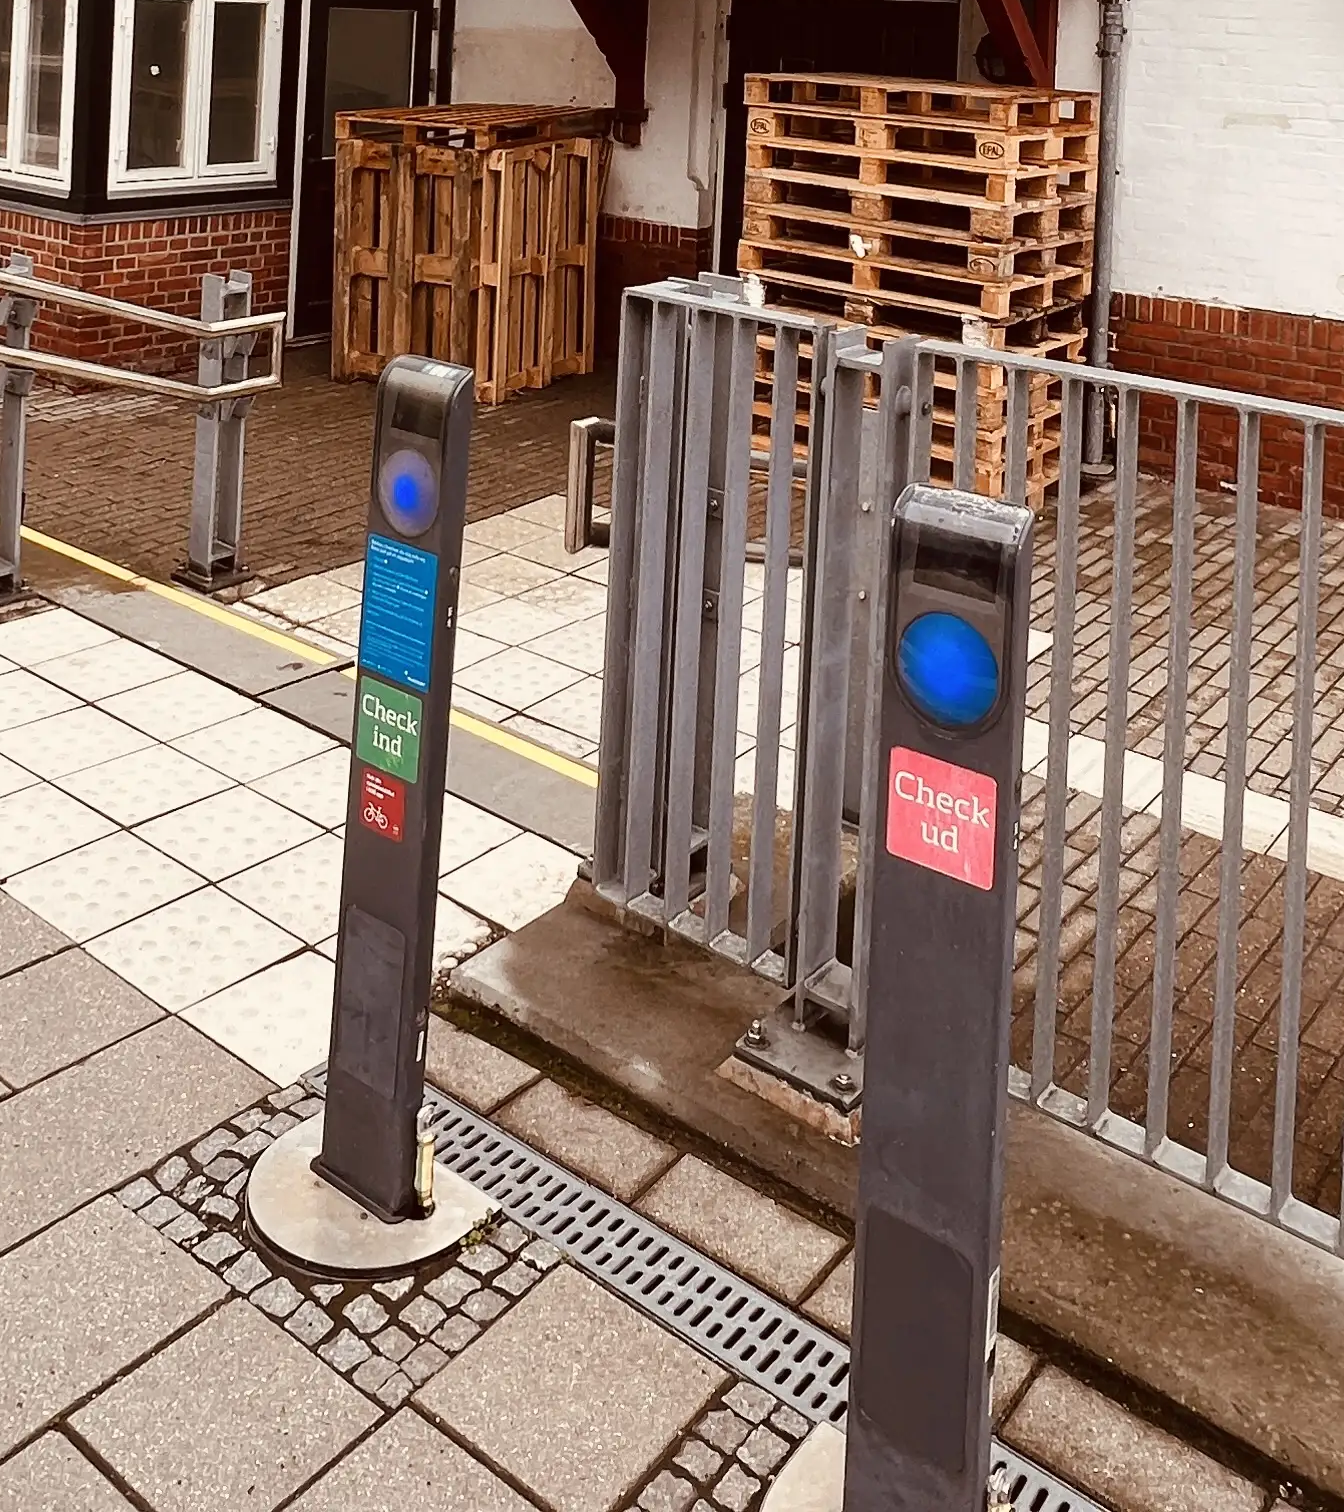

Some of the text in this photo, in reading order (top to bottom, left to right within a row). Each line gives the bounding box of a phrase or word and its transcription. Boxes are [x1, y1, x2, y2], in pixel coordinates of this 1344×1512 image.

[362, 693, 418, 737] Check
[372, 724, 404, 758] ind
[894, 770, 991, 829] Check
[920, 821, 960, 854] ud
